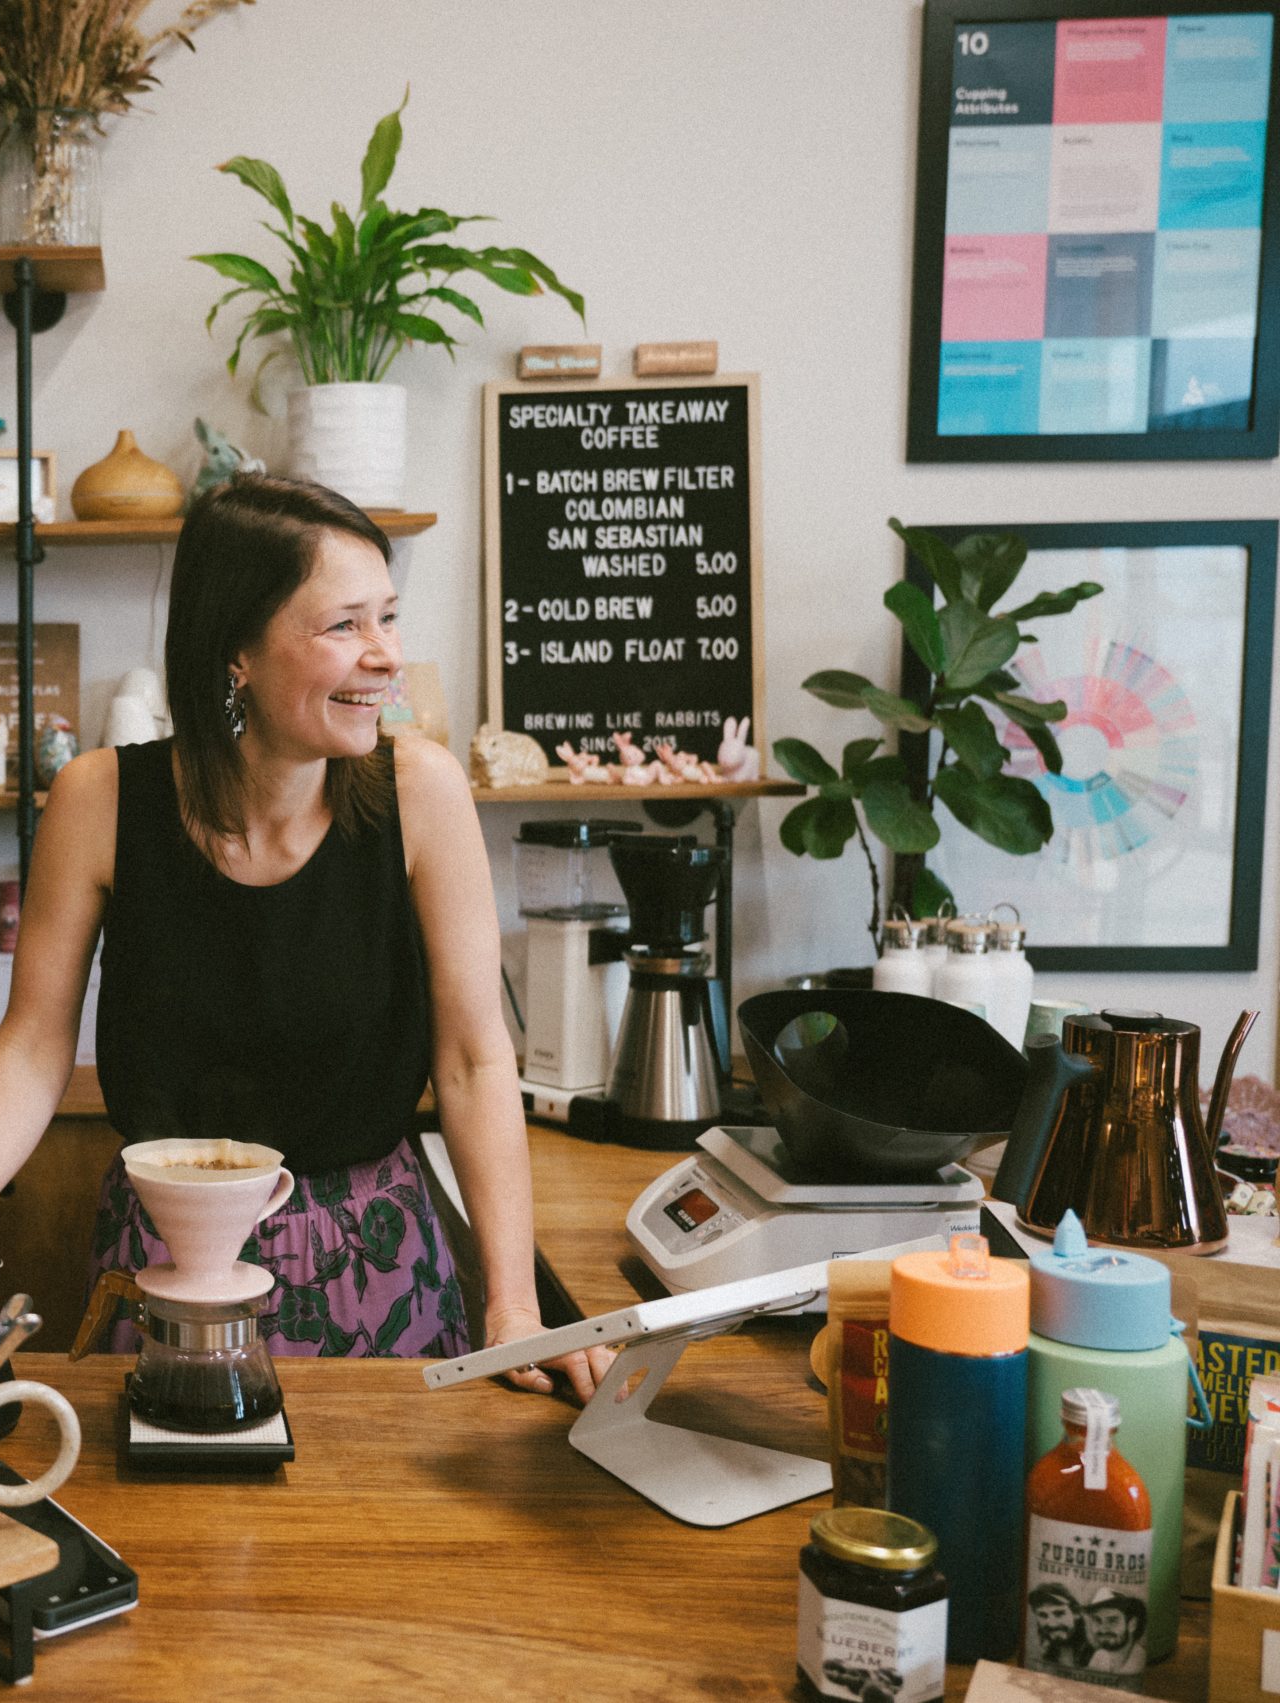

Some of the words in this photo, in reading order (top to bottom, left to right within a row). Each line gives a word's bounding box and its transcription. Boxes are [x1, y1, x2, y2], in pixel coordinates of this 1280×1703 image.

[957, 32, 989, 56] 10
[955, 86, 1008, 103] Cupping
[954, 101, 1019, 115] Attributes
[509, 404, 612, 429] SPECIALTY
[625, 400, 729, 425] TAKEAWAY
[580, 425, 660, 450] COFFEE
[536, 469, 598, 494] BATCH
[602, 467, 660, 493] BREW
[663, 465, 735, 490] FILTER
[564, 496, 685, 522] COLOMBIAN
[547, 526, 588, 550] SAN
[594, 524, 703, 549] SEBASTIAN
[582, 553, 667, 578] WASHED
[695, 551, 738, 575] 5.00
[537, 596, 590, 621] COLD
[594, 595, 655, 621] BREW
[696, 594, 738, 619] 5.00
[540, 639, 613, 664] ISLAND
[624, 637, 686, 663] FLOAT
[697, 637, 739, 661] 7.00
[523, 713, 594, 731] BREWING
[606, 711, 642, 729] LIKE
[655, 710, 721, 728] RABBITS
[580, 736, 619, 753] SINC
[1104, 1552, 1146, 1571] BROS
[846, 1652, 882, 1668] JAM
